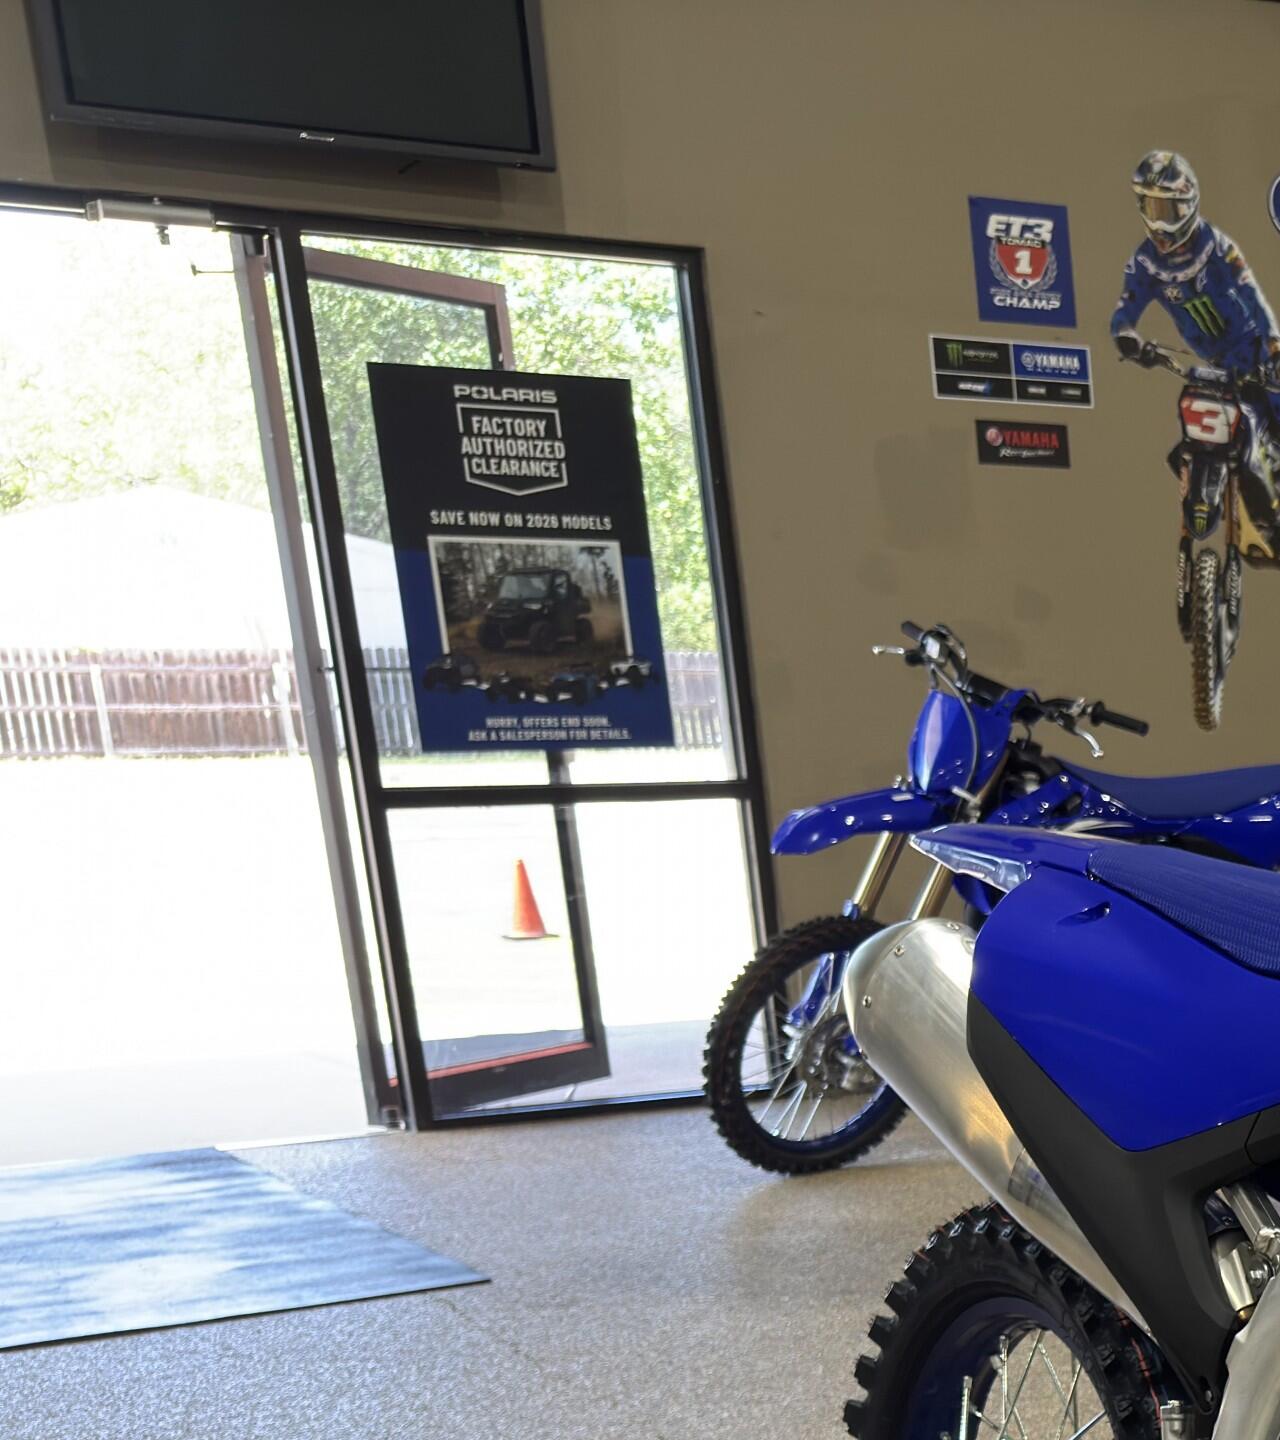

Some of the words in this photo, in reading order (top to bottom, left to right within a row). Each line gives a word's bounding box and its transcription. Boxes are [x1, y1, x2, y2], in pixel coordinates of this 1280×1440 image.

[986, 213, 1054, 243] ET3
[1014, 250, 1033, 275] 1
[993, 295, 1061, 312] CHAMP
[1034, 351, 1082, 371] YAMAHA
[453, 384, 558, 404] POLARIS
[471, 415, 547, 438] FACTORY
[1188, 400, 1231, 444] 3
[461, 436, 566, 459] AUTHORIZED
[1004, 430, 1061, 449] YAMAHA
[471, 457, 560, 478] CLEARANCE
[430, 509, 466, 526] SAVE
[469, 511, 501, 527] NOW
[504, 513, 524, 528] ON
[562, 515, 613, 531] MODELS
[522, 716, 559, 728] OFFERS
[561, 717, 581, 728] END
[468, 730, 489, 741] ASK
[499, 729, 568, 741] SALESPERSON
